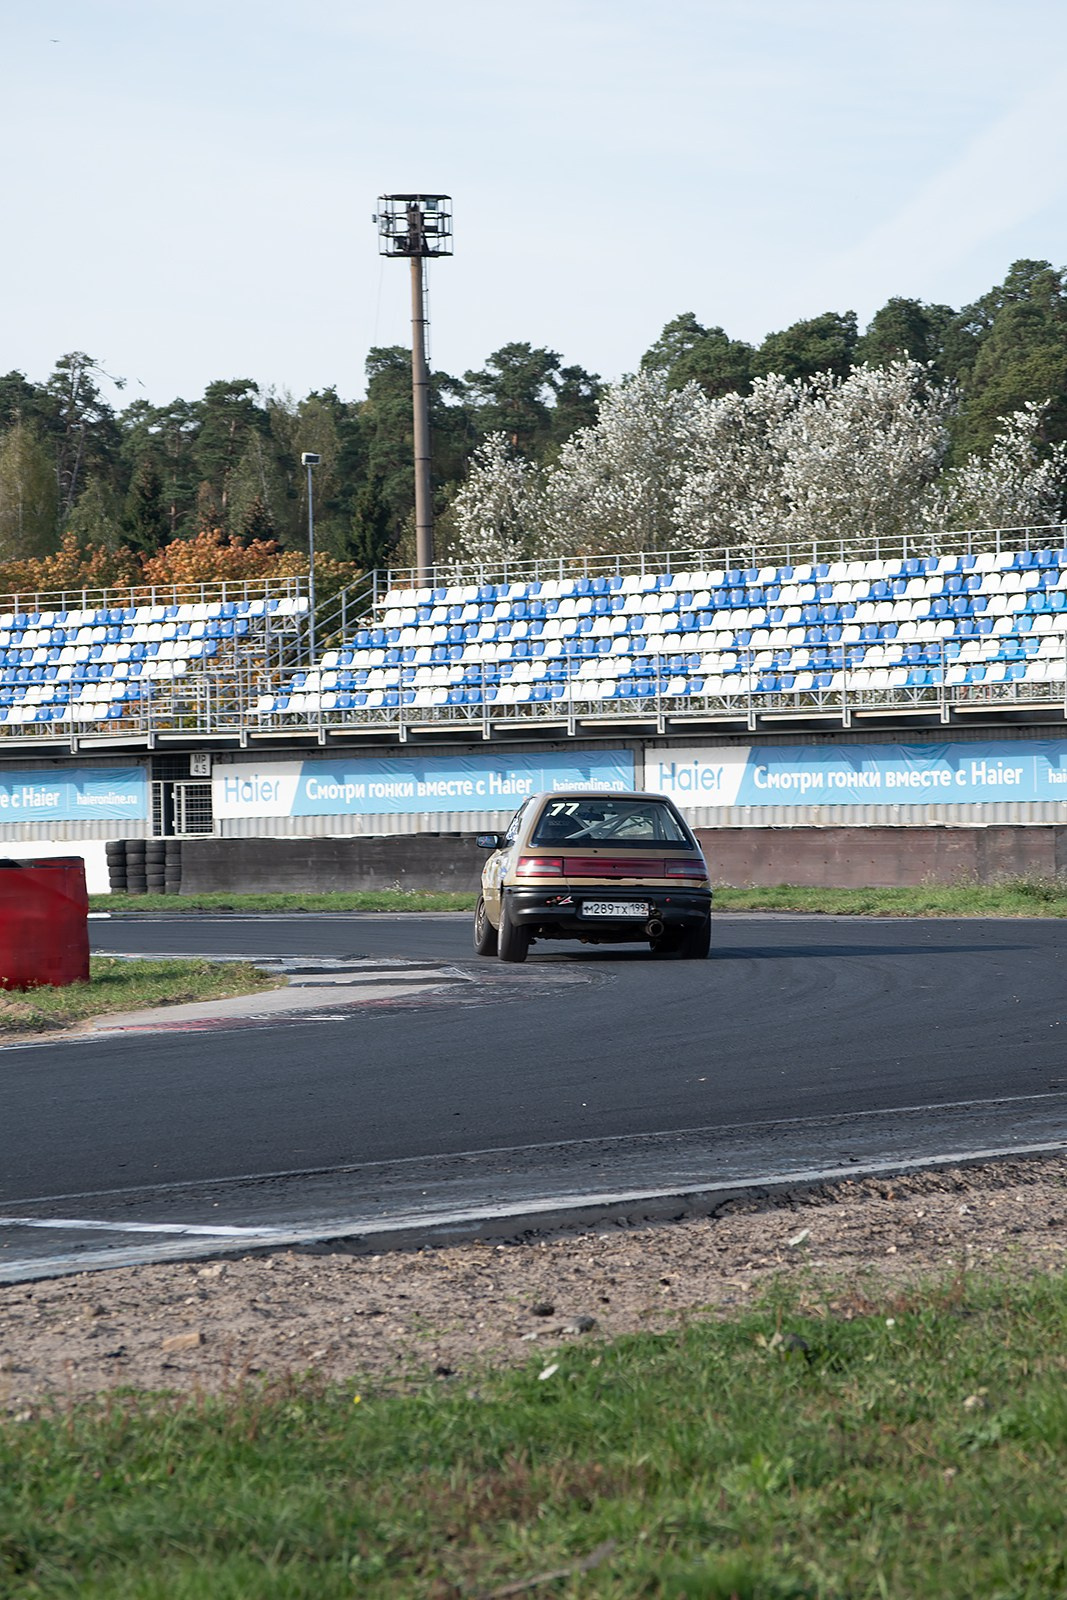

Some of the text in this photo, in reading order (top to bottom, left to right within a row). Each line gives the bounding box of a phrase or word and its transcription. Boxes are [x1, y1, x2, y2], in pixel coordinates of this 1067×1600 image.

[194, 764, 206, 774] 4.5
[658, 760, 723, 791] Haier
[754, 761, 1023, 794] Смотри гонки вместе с Haier
[224, 774, 280, 803] Haier
[305, 772, 532, 804] Смотри гонки вместе с Haier
[552, 778, 624, 791] haieronline.ru
[22, 787, 60, 808] Haier
[76, 792, 138, 805] haieronline.ru
